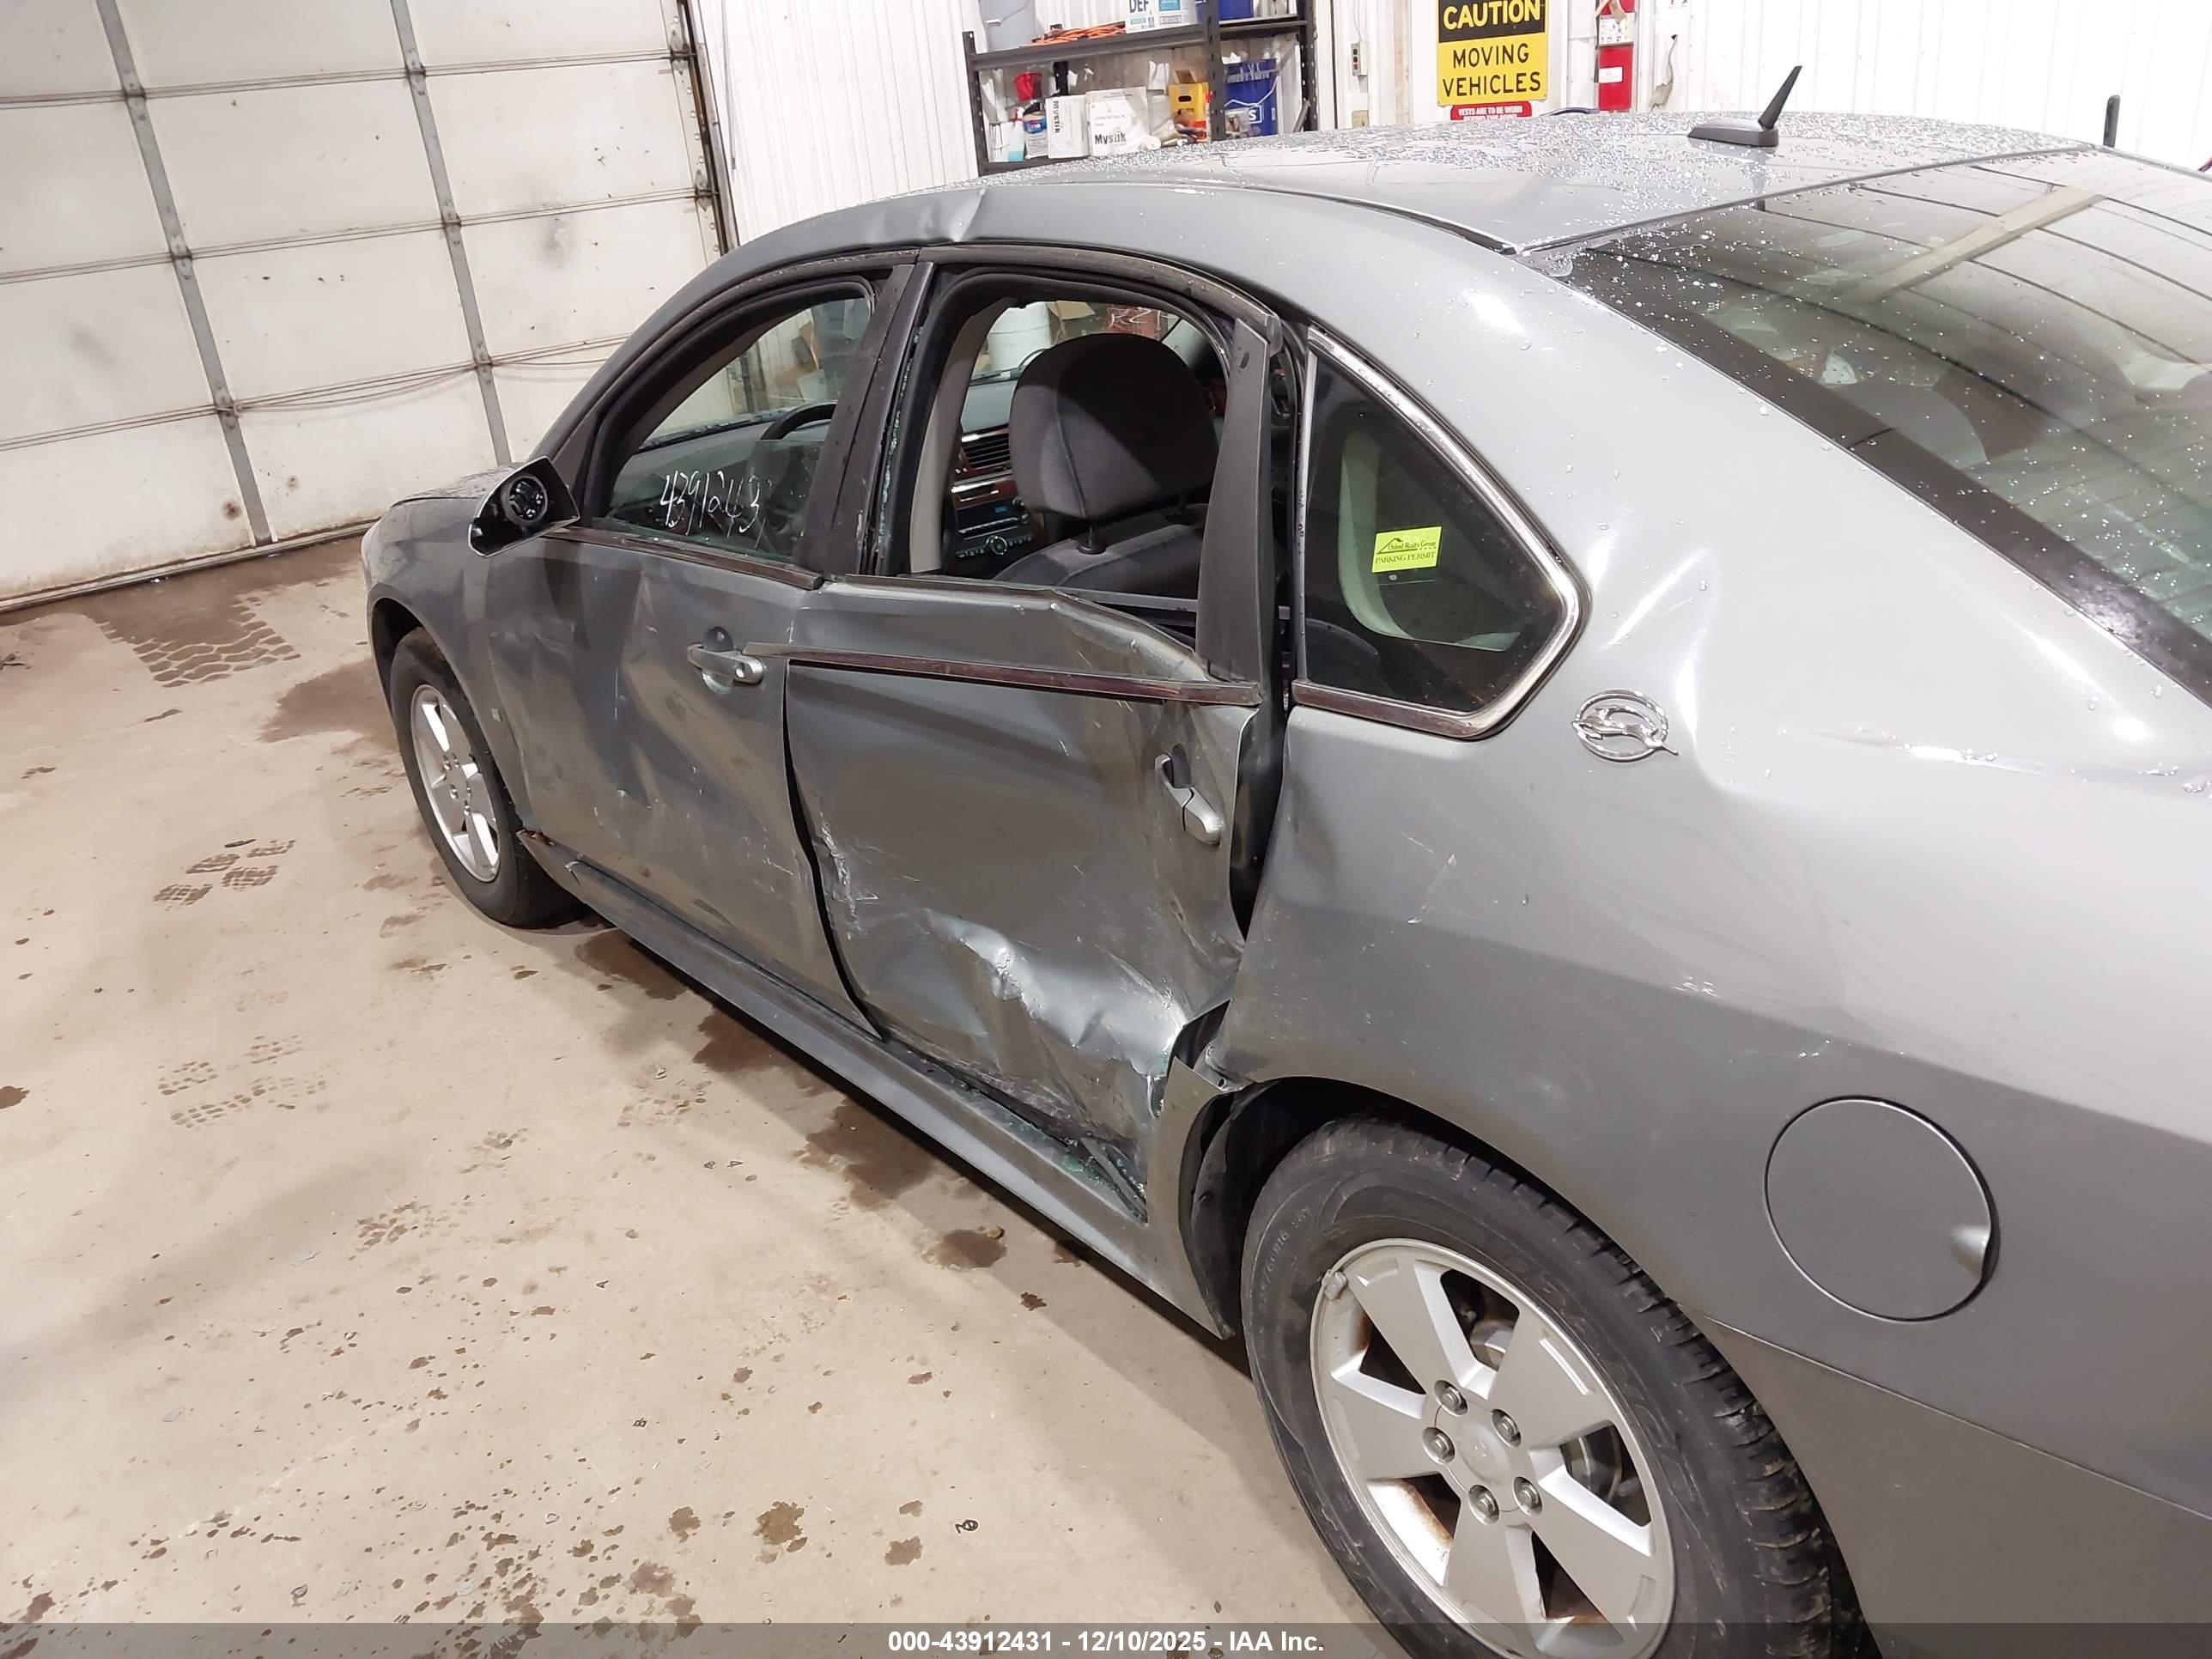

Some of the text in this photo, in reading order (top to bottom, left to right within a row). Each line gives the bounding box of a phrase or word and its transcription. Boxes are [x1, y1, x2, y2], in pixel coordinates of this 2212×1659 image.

[1129, 0, 1149, 13] DEF
[1443, 0, 1541, 30] CAUTION
[1453, 42, 1529, 69] MOVING
[1443, 71, 1540, 97] VEHICLES
[1458, 108, 1476, 117] VESTS
[1496, 106, 1504, 114] BE
[1095, 132, 1127, 145] Mystik
[1375, 551, 1437, 564] PARKING PERMIT
